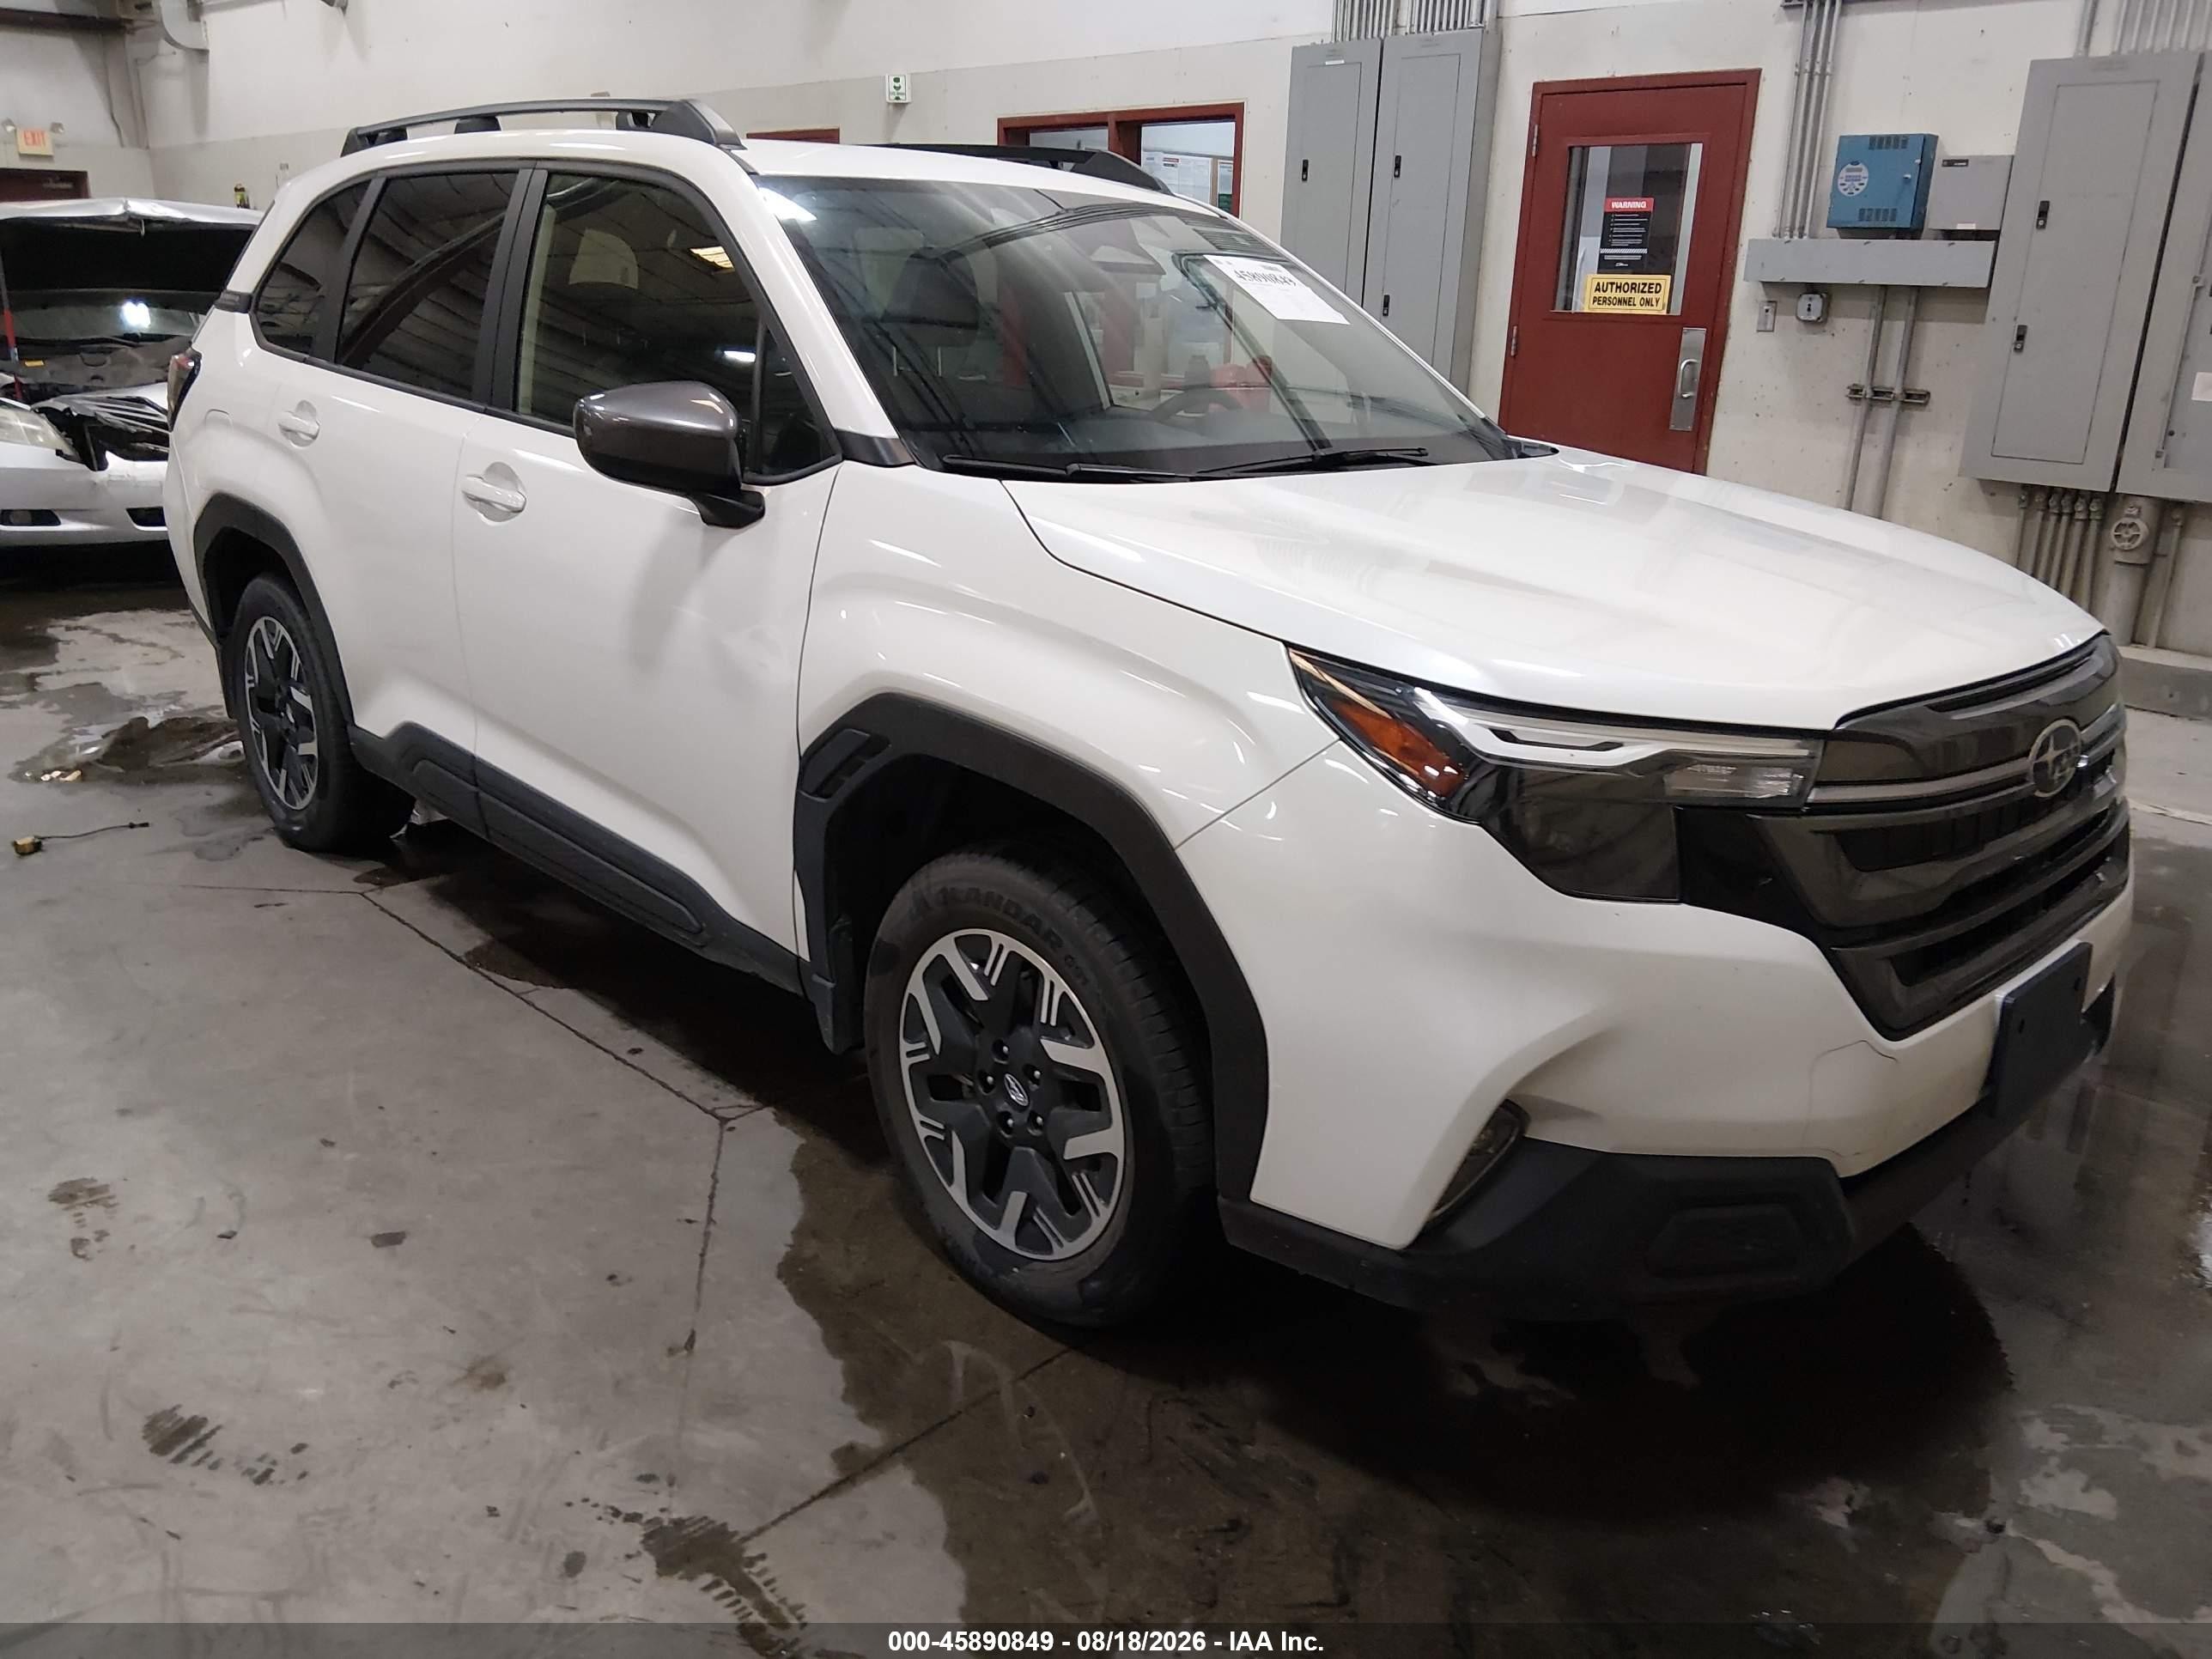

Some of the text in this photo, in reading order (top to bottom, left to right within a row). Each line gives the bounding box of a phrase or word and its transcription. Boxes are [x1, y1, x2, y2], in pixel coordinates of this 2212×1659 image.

[23, 131, 46, 147] EXIT
[1594, 282, 1662, 295] AUTHORIZED
[1592, 296, 1661, 307] PERSONNEL ONLY
